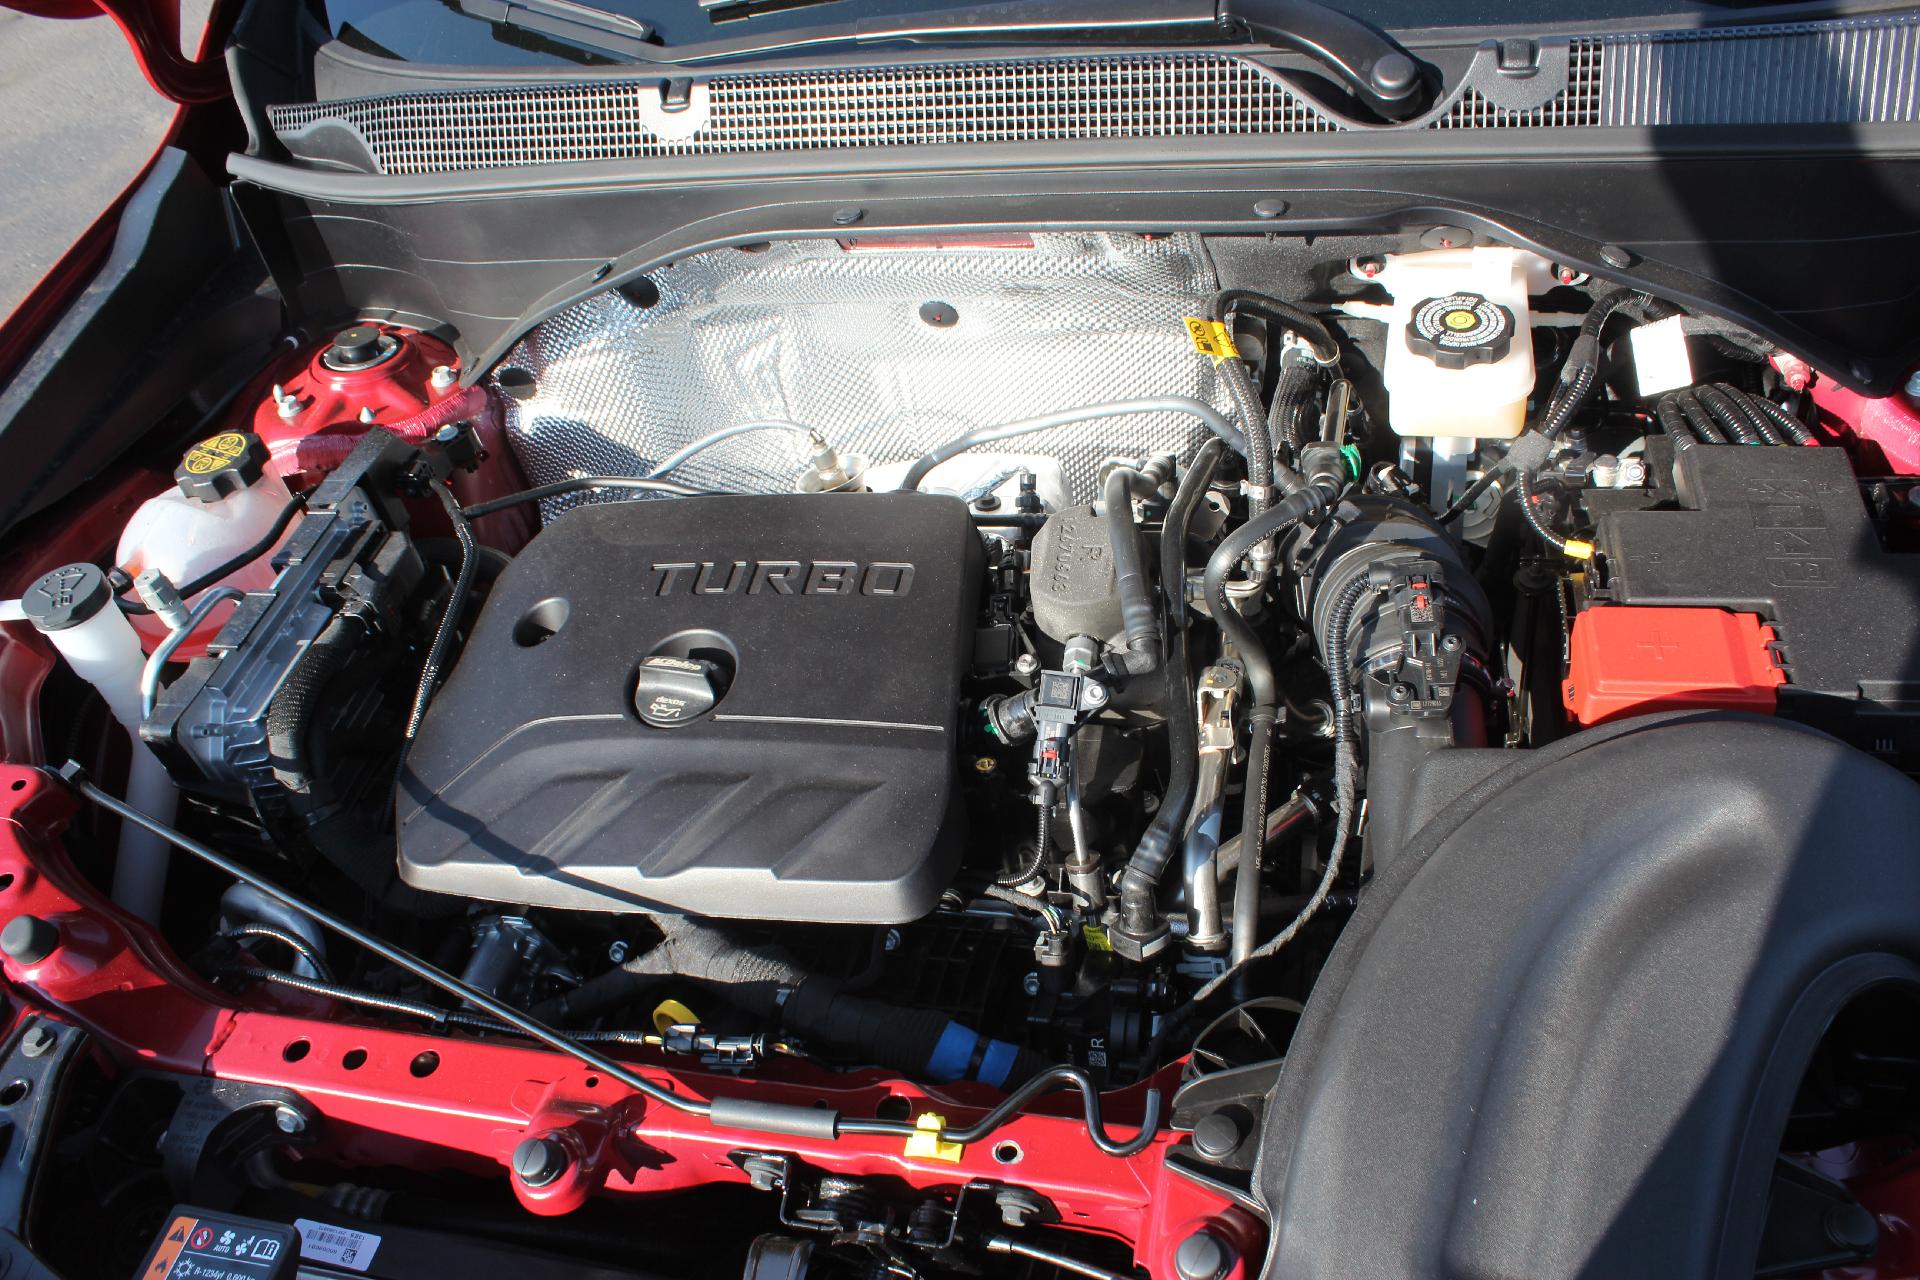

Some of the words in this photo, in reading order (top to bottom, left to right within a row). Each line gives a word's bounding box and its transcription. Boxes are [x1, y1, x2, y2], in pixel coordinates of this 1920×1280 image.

[652, 560, 915, 596] TURBO
[656, 695, 686, 707] dexos
[1091, 1038, 1105, 1049] R
[213, 1244, 230, 1253] AUTO
[194, 1266, 226, 1280] R-1234yf
